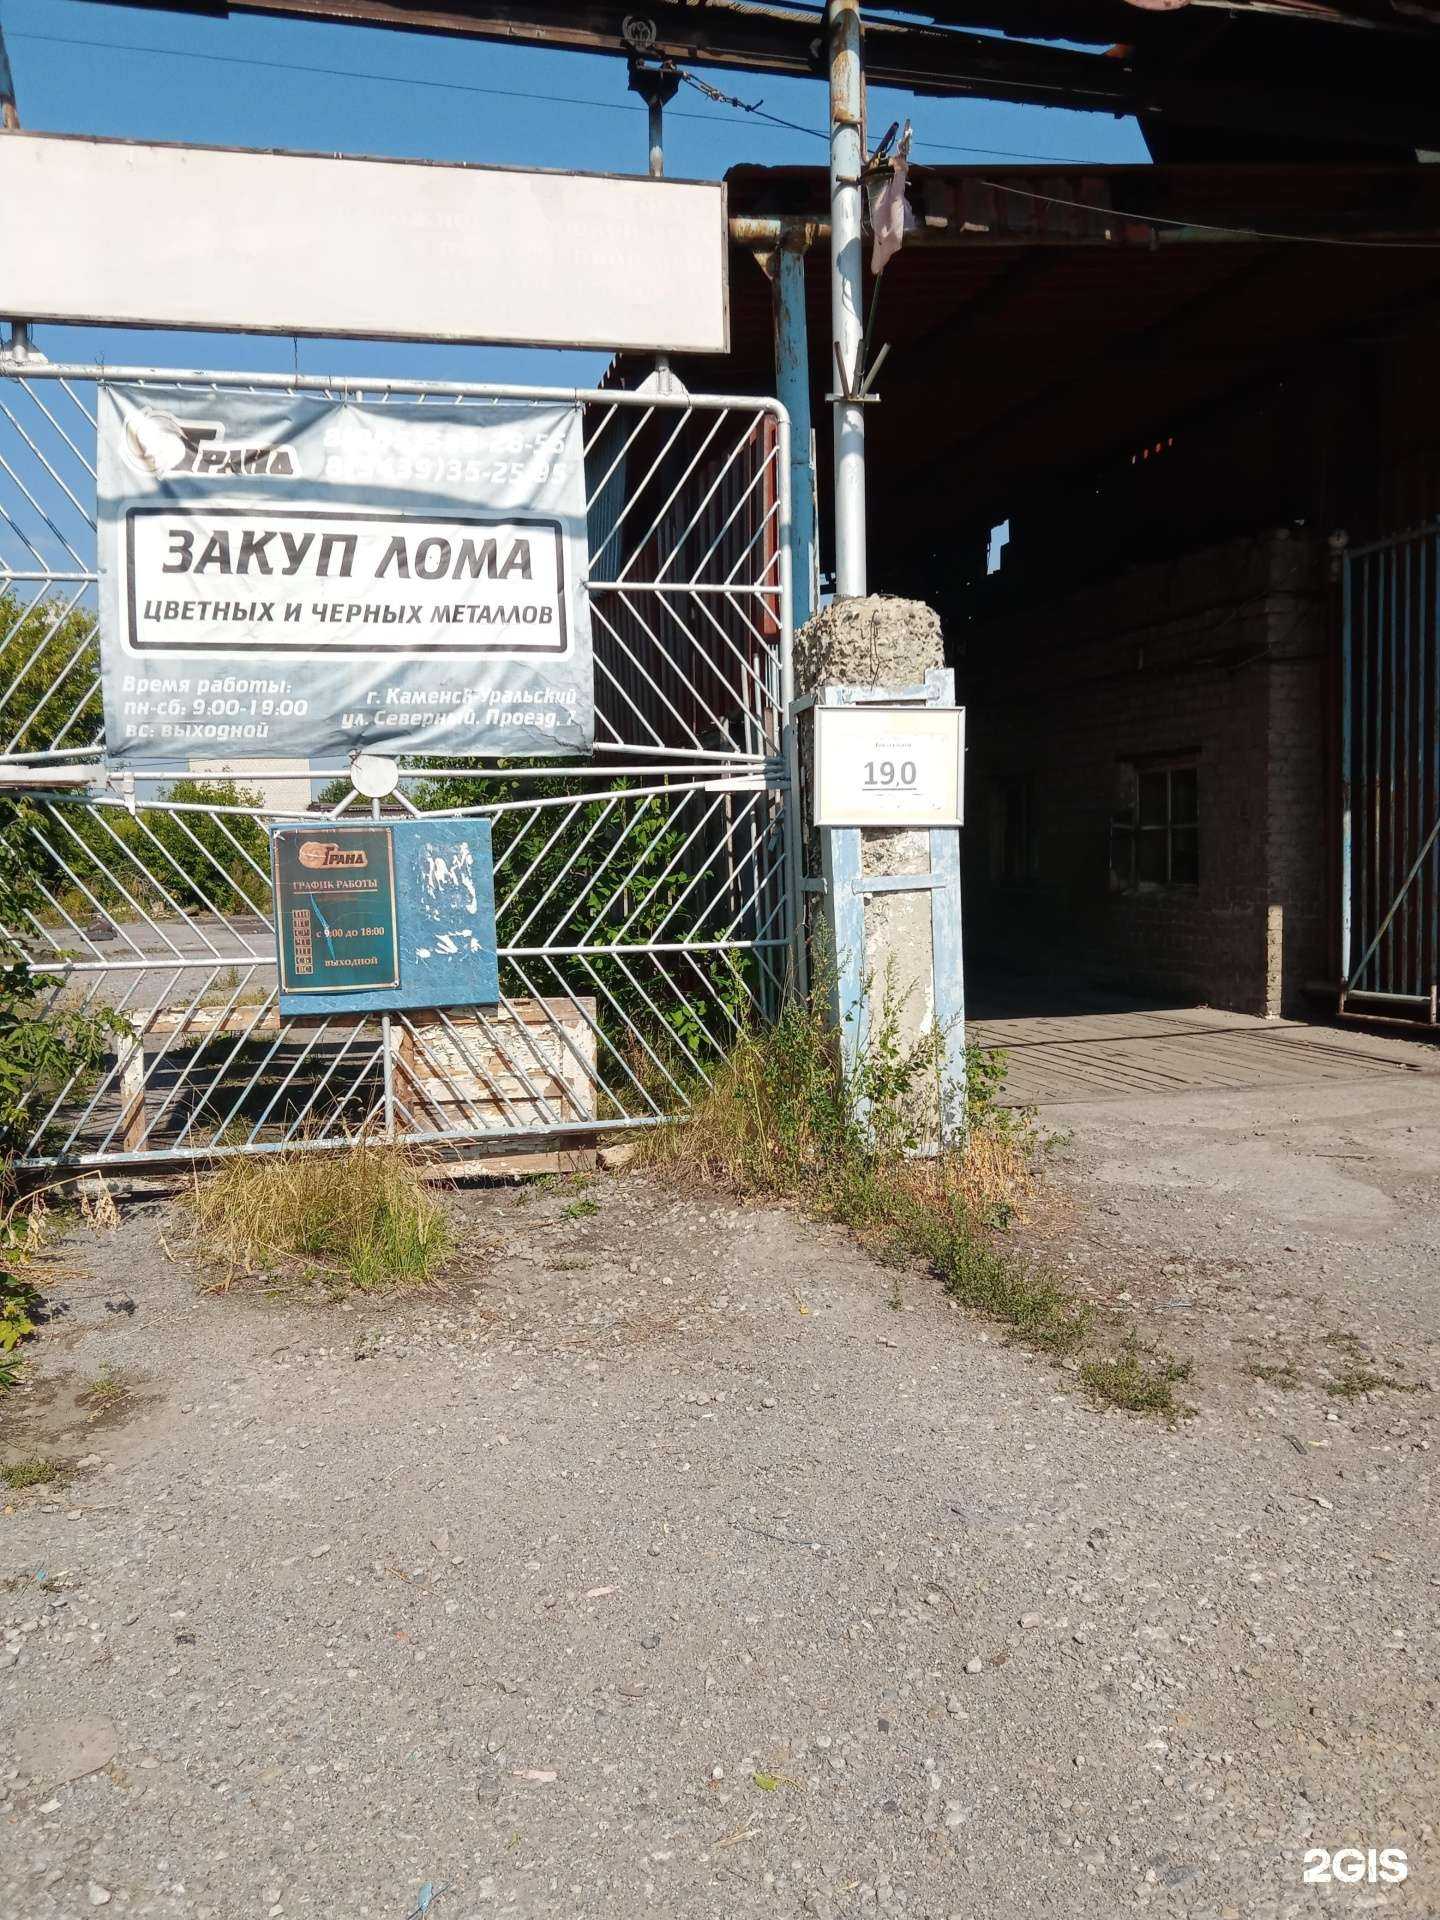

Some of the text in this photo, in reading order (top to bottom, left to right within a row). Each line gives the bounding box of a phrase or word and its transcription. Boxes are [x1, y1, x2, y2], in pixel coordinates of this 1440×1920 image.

[162, 529, 533, 580] ЗАКУП ЛОМА
[143, 600, 553, 624] ЦВЕТНЫХ И ЧЕРНЫХ МЕТАЛЛОВ
[122, 676, 292, 695] Время работы:
[366, 687, 577, 705] г. Каменск-Уральский
[123, 700, 309, 717] пн-сб: 9:00-19:00
[341, 713, 368, 729] ул.
[125, 722, 270, 740] вс: выходной
[864, 761, 917, 787] 19,0
[293, 879, 378, 890] ГРАФИК РАБОТЫ
[361, 926, 385, 936] 18:00
[325, 957, 379, 967] выходной
